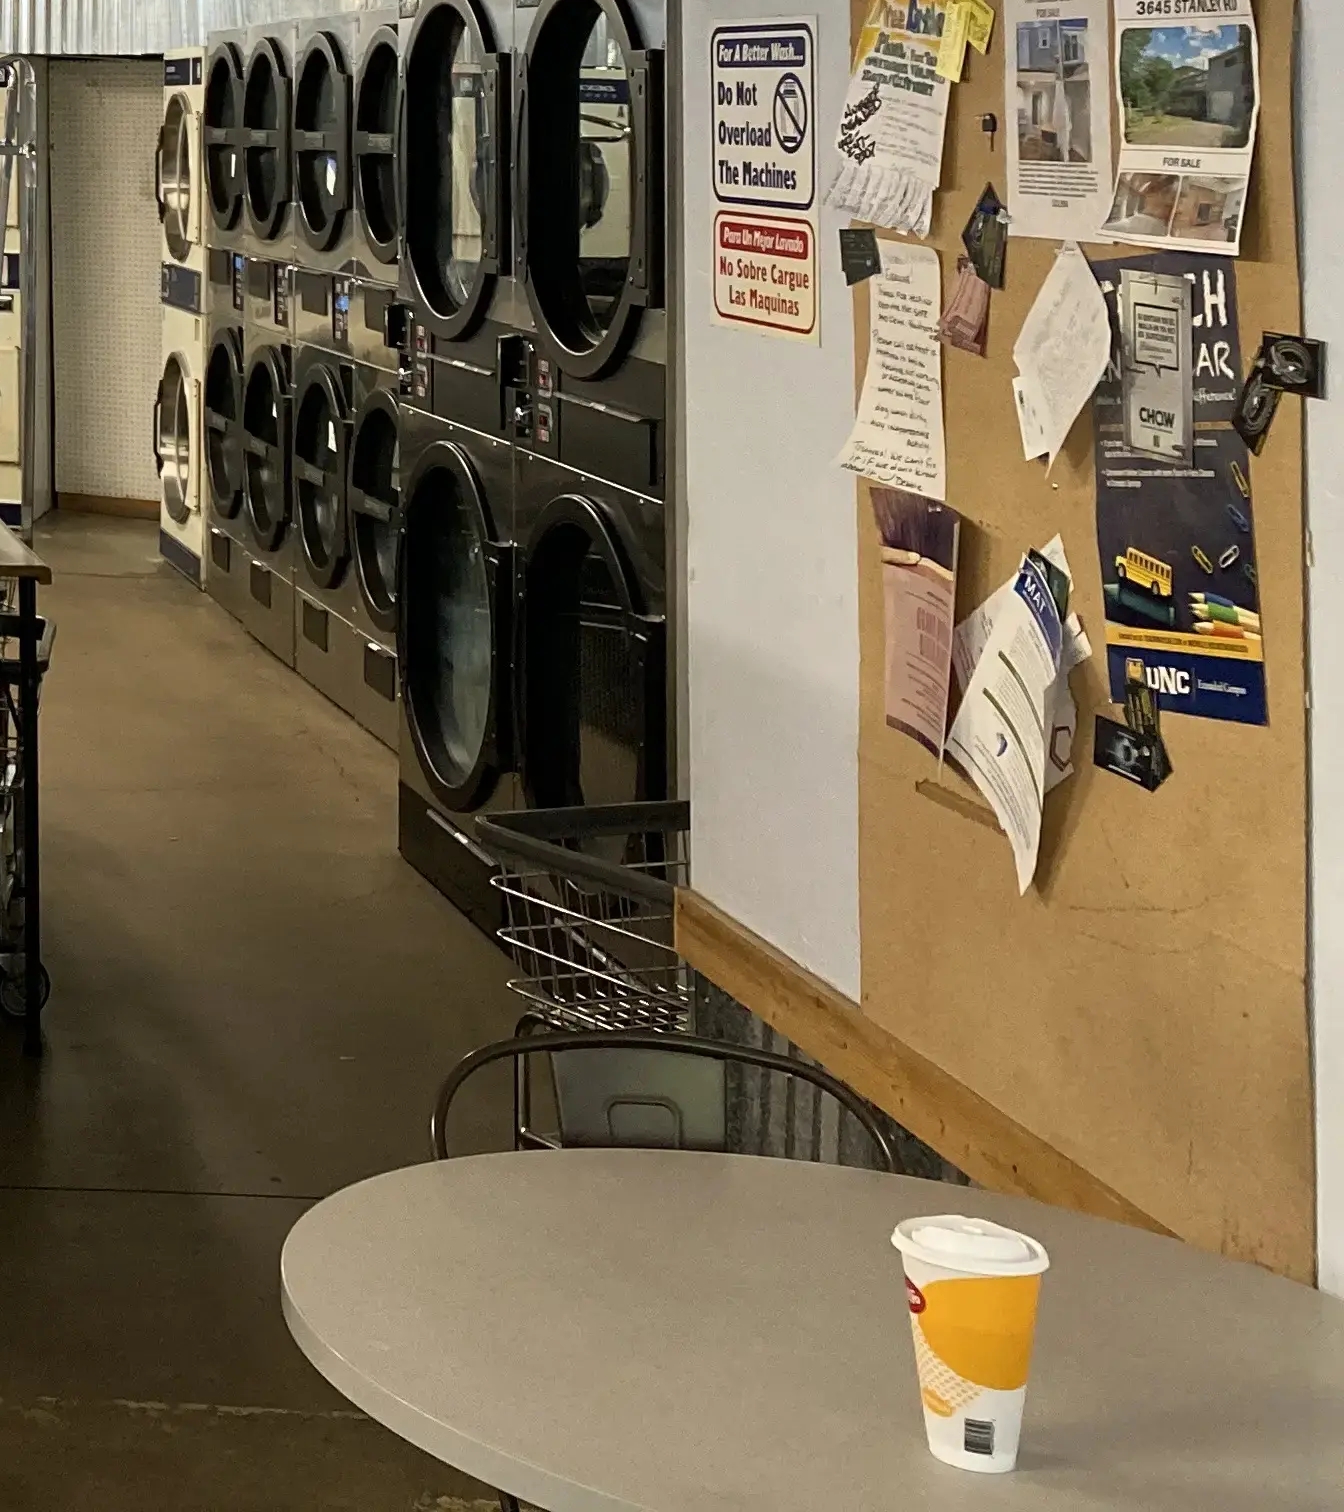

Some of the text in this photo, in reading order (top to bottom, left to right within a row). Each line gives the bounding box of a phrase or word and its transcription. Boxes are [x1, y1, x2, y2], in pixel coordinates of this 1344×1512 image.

[1136, 0, 1172, 15] 3645
[719, 43, 733, 63] For
[734, 44, 741, 62] A
[743, 43, 770, 62] Better
[718, 81, 758, 107] Do Not
[718, 121, 772, 148] Overload
[719, 159, 797, 190] The Machines
[1163, 156, 1201, 169] FOR SALE
[723, 227, 804, 253] Para Un Mejor Lavado
[719, 255, 810, 292] No Sobre Cargue
[729, 285, 800, 318] Las Maquinas
[1139, 406, 1175, 429] CHOW
[1023, 575, 1047, 616] MAT
[1145, 666, 1190, 695] UNC
